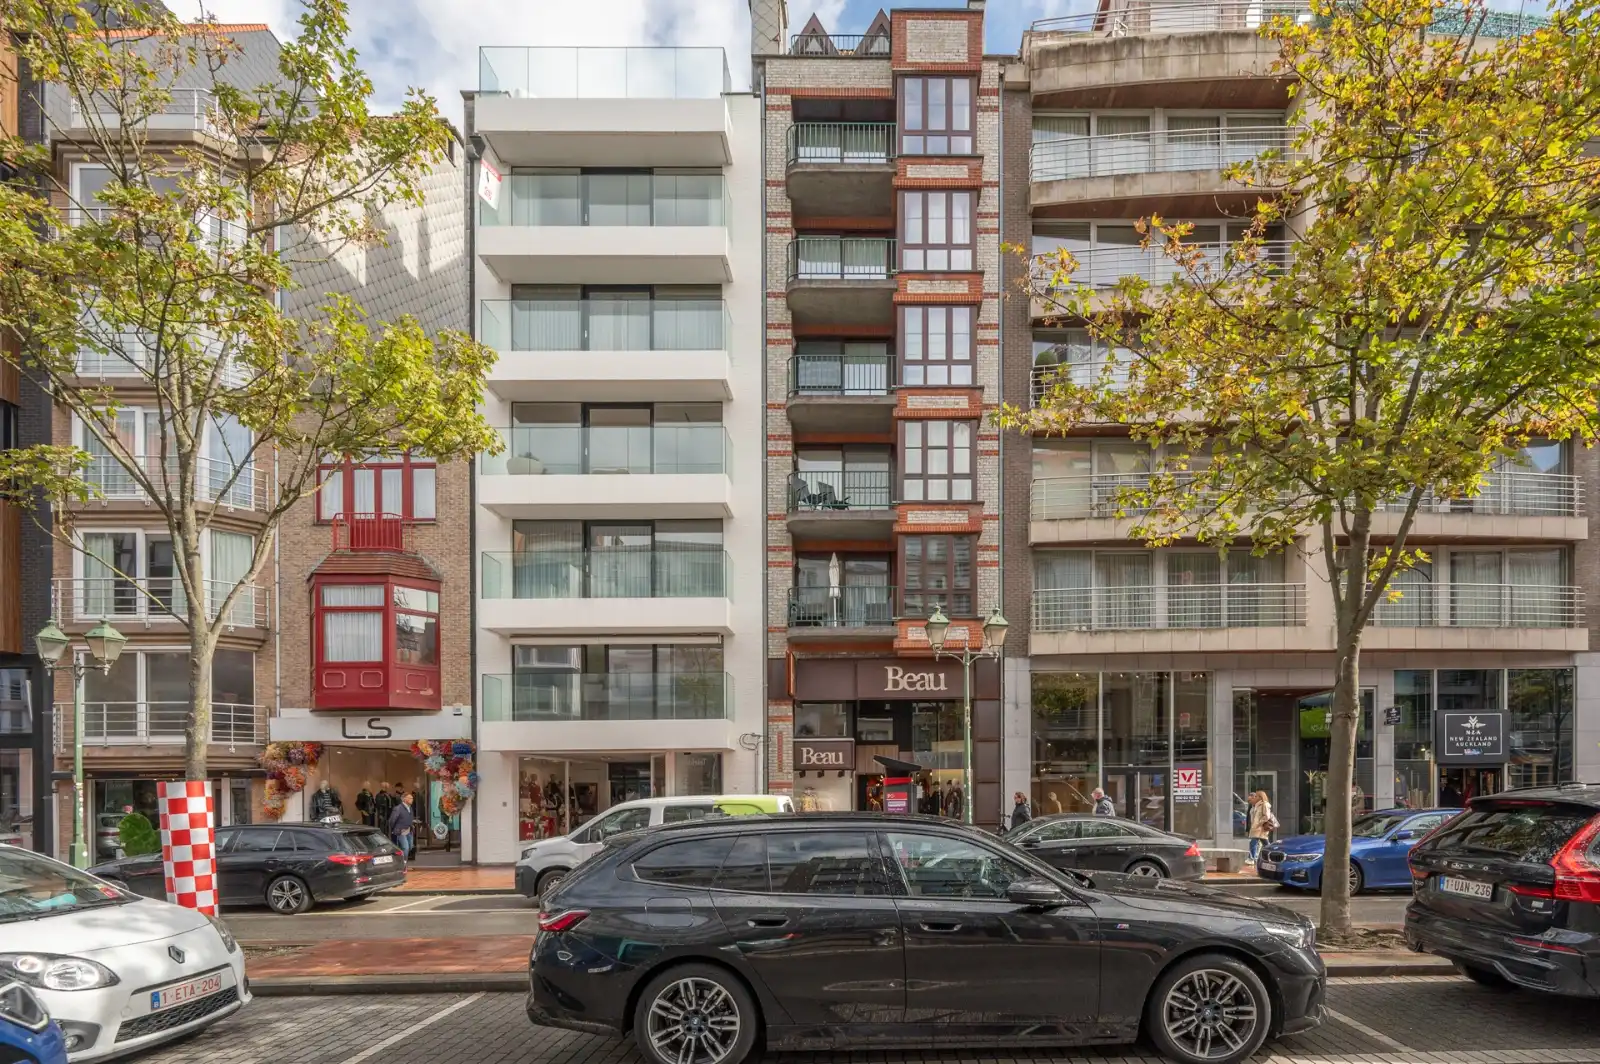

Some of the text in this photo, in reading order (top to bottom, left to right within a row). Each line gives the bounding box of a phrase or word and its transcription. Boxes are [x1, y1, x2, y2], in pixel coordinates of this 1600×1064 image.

[884, 666, 947, 691] Beau
[341, 717, 392, 739] LS
[800, 748, 844, 765] Beau
[1444, 879, 1491, 897] 1-UAN-236
[162, 977, 219, 1004] 1-ETA-204
